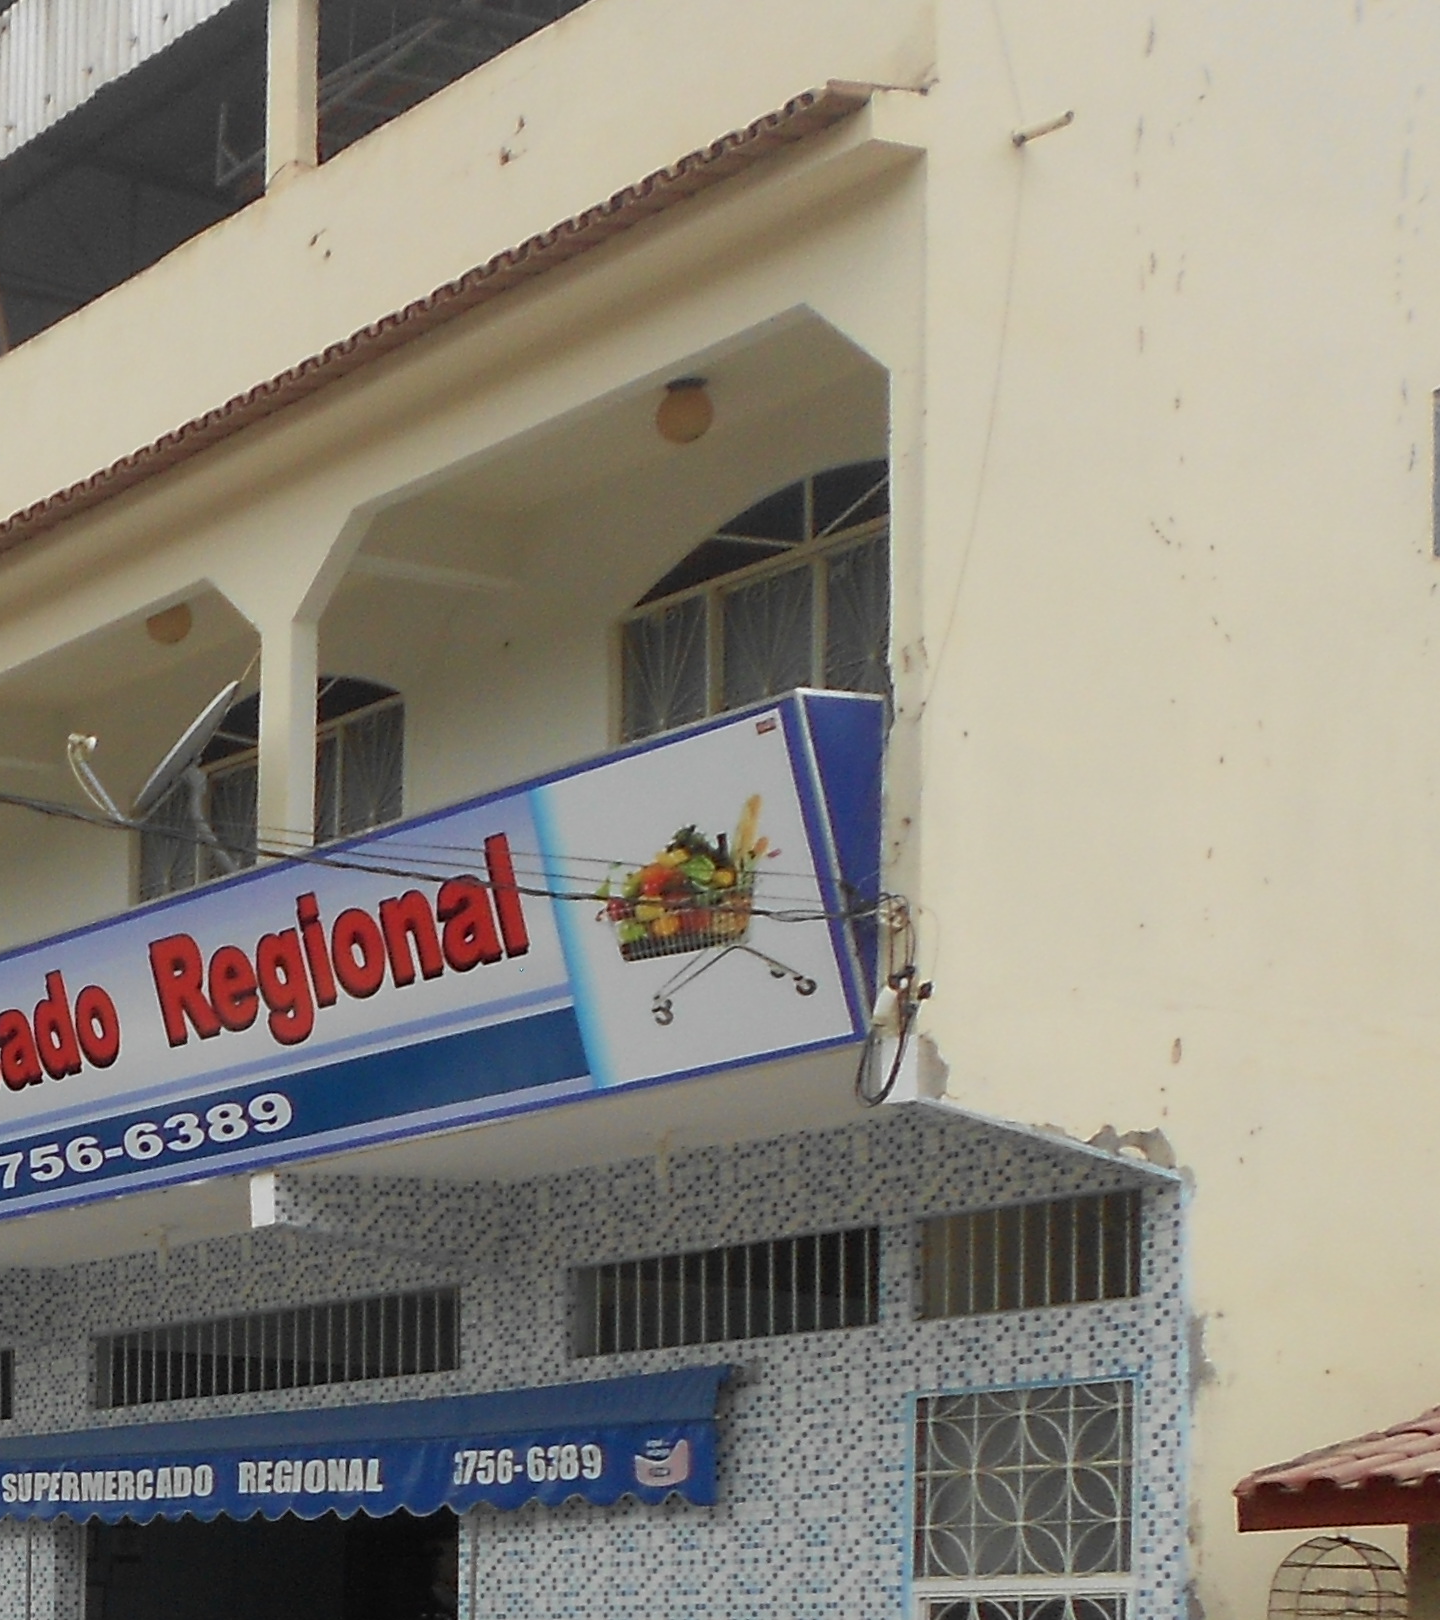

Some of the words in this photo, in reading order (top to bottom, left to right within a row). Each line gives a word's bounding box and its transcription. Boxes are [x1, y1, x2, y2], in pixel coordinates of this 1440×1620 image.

[148, 832, 529, 1048] Regional
[1, 1464, 213, 1502] SUPERMERCADO
[238, 1458, 383, 1494] REGIONAL
[453, 1444, 602, 1485] 3756-6389
